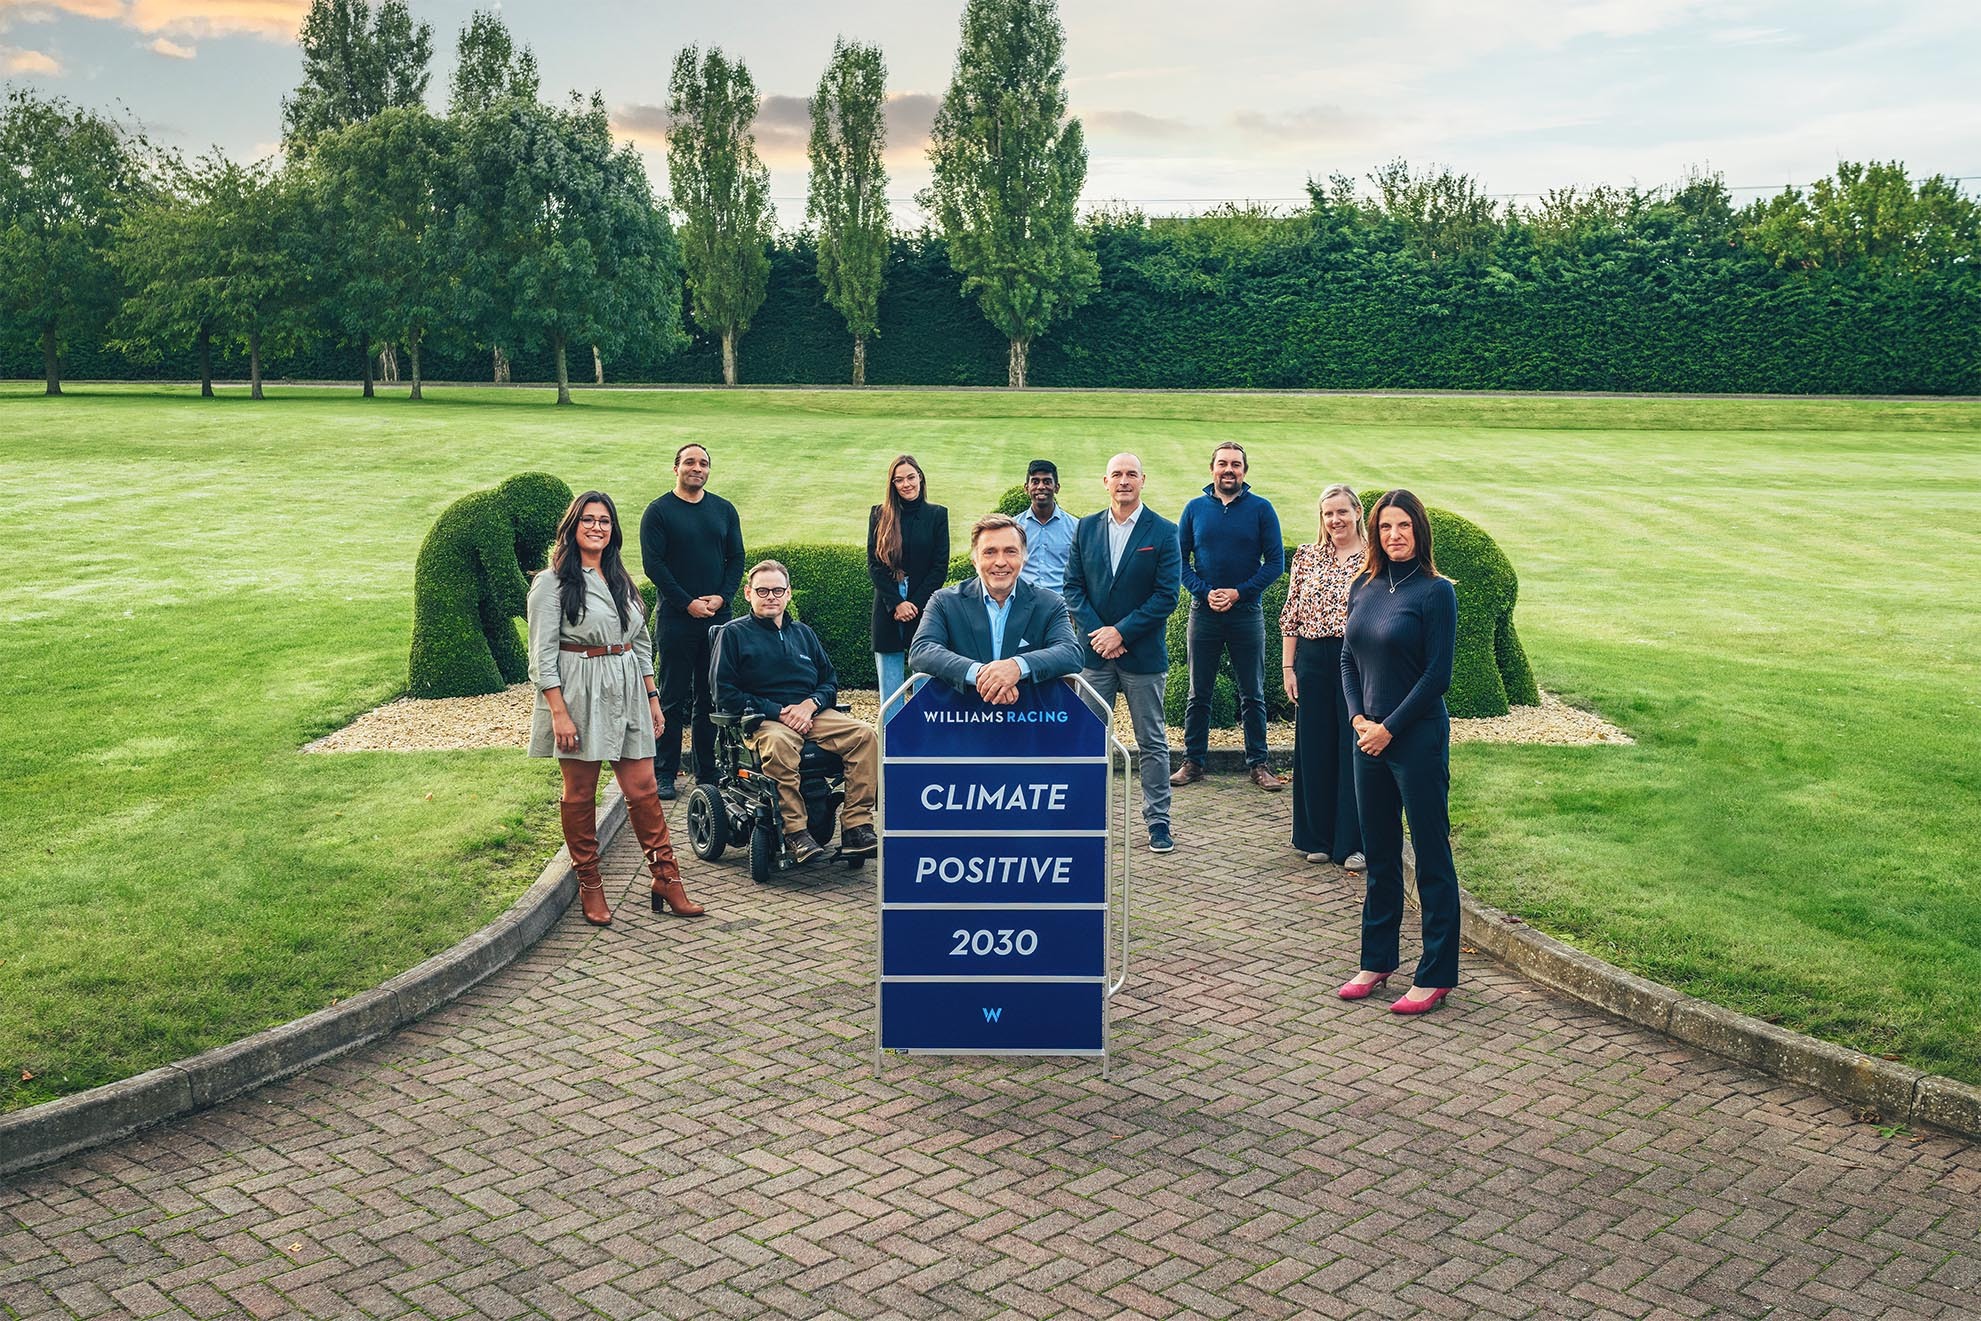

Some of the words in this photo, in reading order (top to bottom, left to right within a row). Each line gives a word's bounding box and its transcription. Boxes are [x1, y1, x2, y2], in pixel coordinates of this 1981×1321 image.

[923, 711, 1004, 723] WILLIAMS
[1006, 711, 1069, 723] RACING
[920, 783, 1069, 811] CLIMATE
[915, 856, 1073, 884] POSITIVE
[948, 929, 1038, 956] 2030
[982, 1007, 1003, 1023] W
